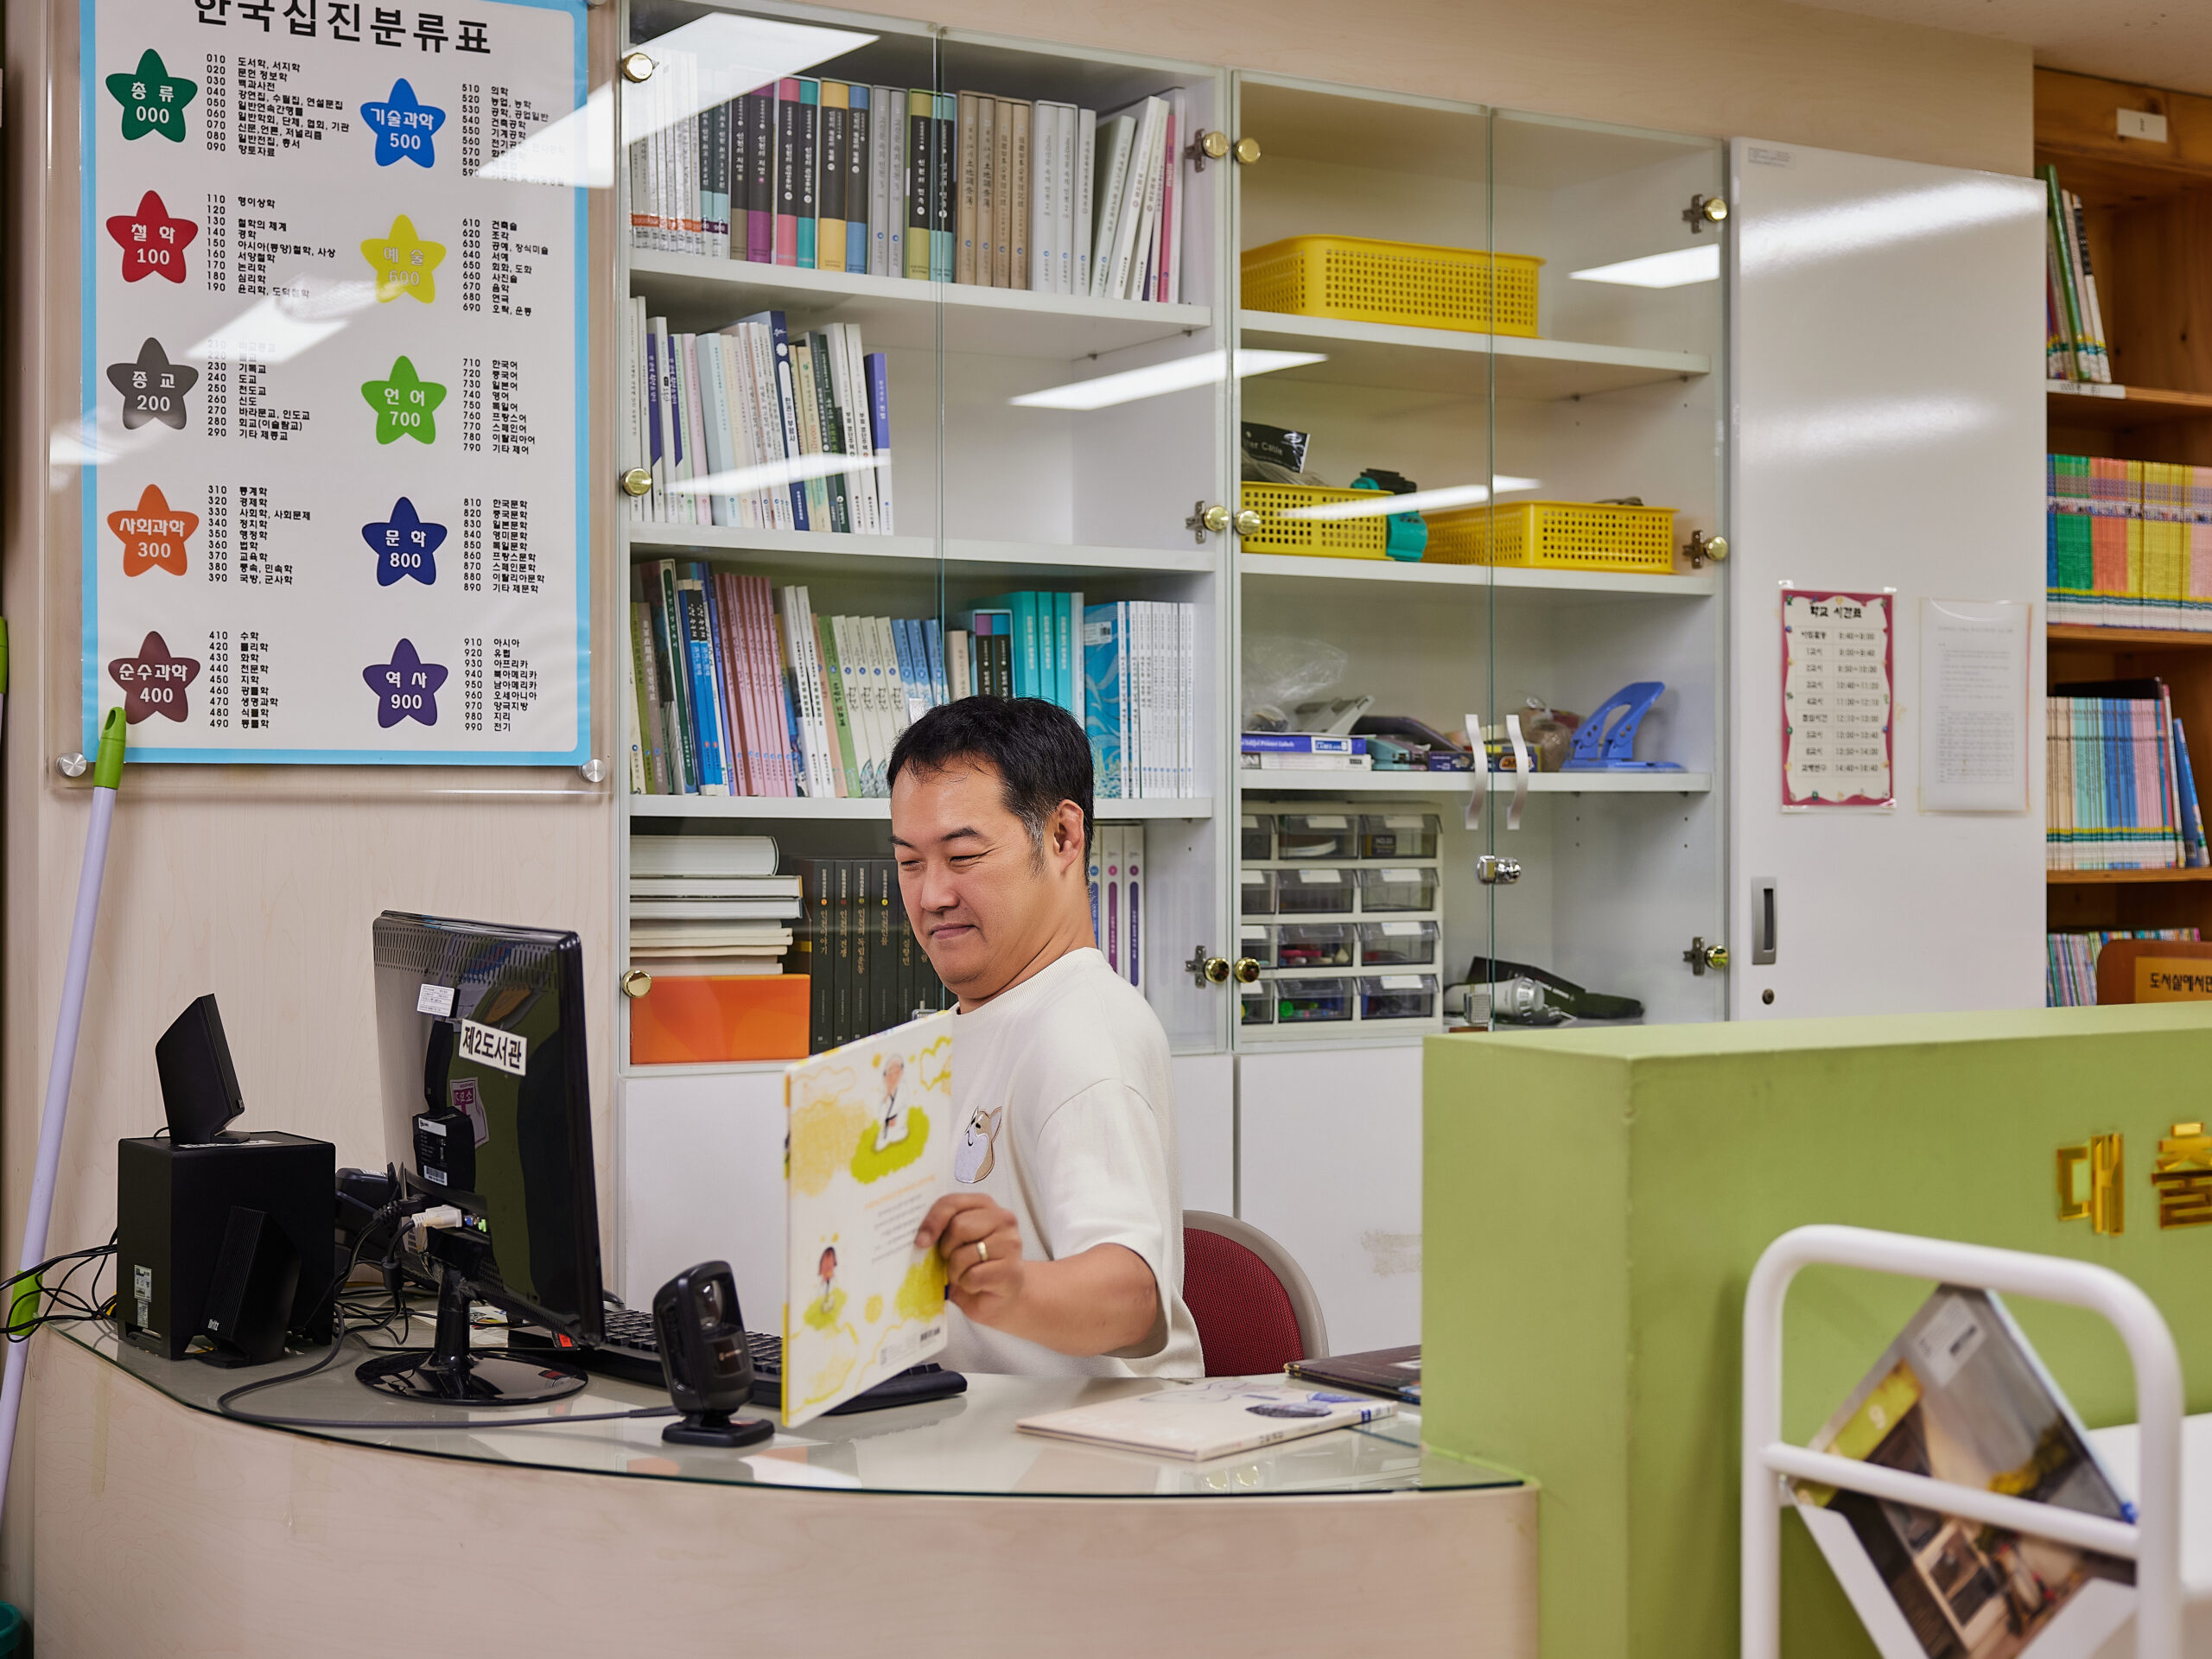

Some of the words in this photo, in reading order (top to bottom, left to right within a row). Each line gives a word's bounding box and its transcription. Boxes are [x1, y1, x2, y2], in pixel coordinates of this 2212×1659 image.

[194, 0, 492, 55] 한국십진분류표
[207, 54, 226, 64] 010
[273, 61, 301, 73] 서지학
[207, 65, 226, 74] 020
[238, 67, 256, 79] 문헌
[462, 84, 480, 93] 510
[491, 86, 508, 96] 의학
[136, 107, 169, 124] 000
[462, 105, 480, 114] 530
[370, 107, 434, 131] 기술과학
[207, 130, 226, 141] 080
[390, 133, 421, 150] 500
[207, 142, 226, 152] 090
[207, 194, 226, 204] 110
[238, 196, 275, 209] 형이상학
[207, 205, 226, 214] 120
[207, 226, 226, 237] 140
[238, 229, 256, 240] 경학
[462, 229, 480, 238] 620
[492, 231, 509, 240] 조각
[137, 248, 170, 265] 100
[207, 249, 226, 259] 160
[238, 251, 275, 264] 서양철학
[463, 250, 480, 259] 640
[207, 260, 226, 270] 170
[238, 263, 266, 273] 논리학
[463, 261, 480, 270] 650
[515, 264, 532, 275] 도화
[207, 271, 226, 281] 180
[238, 273, 266, 284] 심리학
[389, 270, 420, 286] 600
[463, 358, 480, 367] 710
[493, 359, 518, 370] 한국어
[207, 372, 226, 382] 240
[238, 374, 257, 384] 도교
[207, 384, 226, 393] 250
[238, 385, 266, 396] 천도교
[463, 390, 480, 399] 740
[493, 391, 509, 401] 영어
[137, 395, 170, 412] 200
[207, 394, 226, 404] 260
[238, 396, 257, 406] 신도
[207, 405, 226, 415] 270
[283, 410, 309, 420] 인도교
[463, 411, 480, 420] 760
[389, 411, 421, 428] 700
[463, 422, 480, 430] 770
[493, 423, 526, 434] 스페인어
[208, 496, 226, 505] 320
[240, 498, 268, 508] 경제학
[463, 498, 481, 507] 810
[493, 499, 527, 510] 한국문학
[208, 507, 226, 517] 330
[274, 510, 310, 520] 사회문제
[119, 518, 185, 539] 사회과학
[208, 518, 227, 527] 340
[240, 519, 268, 530] 정치학
[463, 530, 481, 539] 840
[493, 531, 527, 541] 영미문학
[137, 543, 171, 559] 300
[208, 540, 227, 550] 360
[240, 541, 258, 551] 법학
[208, 551, 227, 560] 370
[240, 552, 268, 563] 교육학
[390, 552, 421, 569] 800
[208, 573, 227, 582] 390
[264, 575, 293, 585] 군사학
[463, 582, 481, 591] 890
[493, 583, 510, 593] 기타
[512, 584, 538, 594] 제문학
[209, 631, 228, 639] 410
[240, 632, 259, 641] 수학
[464, 638, 482, 646] 910
[493, 639, 520, 648] 아시아
[209, 653, 228, 662] 430
[240, 653, 259, 663] 화학
[494, 659, 528, 669] 아프리카
[119, 663, 188, 683] 순수과학
[209, 664, 228, 672] 440
[241, 664, 269, 674] 천문학
[209, 675, 228, 683] 450
[241, 676, 259, 684] 지학
[465, 680, 482, 689] 950
[494, 681, 537, 690] 남아메리카
[139, 687, 173, 703] 400
[494, 691, 537, 700] 오세아니아
[209, 697, 228, 706] 470
[241, 697, 278, 707] 생명과학
[391, 694, 422, 710] 900
[465, 712, 482, 721] 980
[494, 712, 510, 721] 지리
[465, 722, 482, 731] 990
[494, 722, 511, 732] 전기
[463, 1027, 521, 1069] 제2도서관
